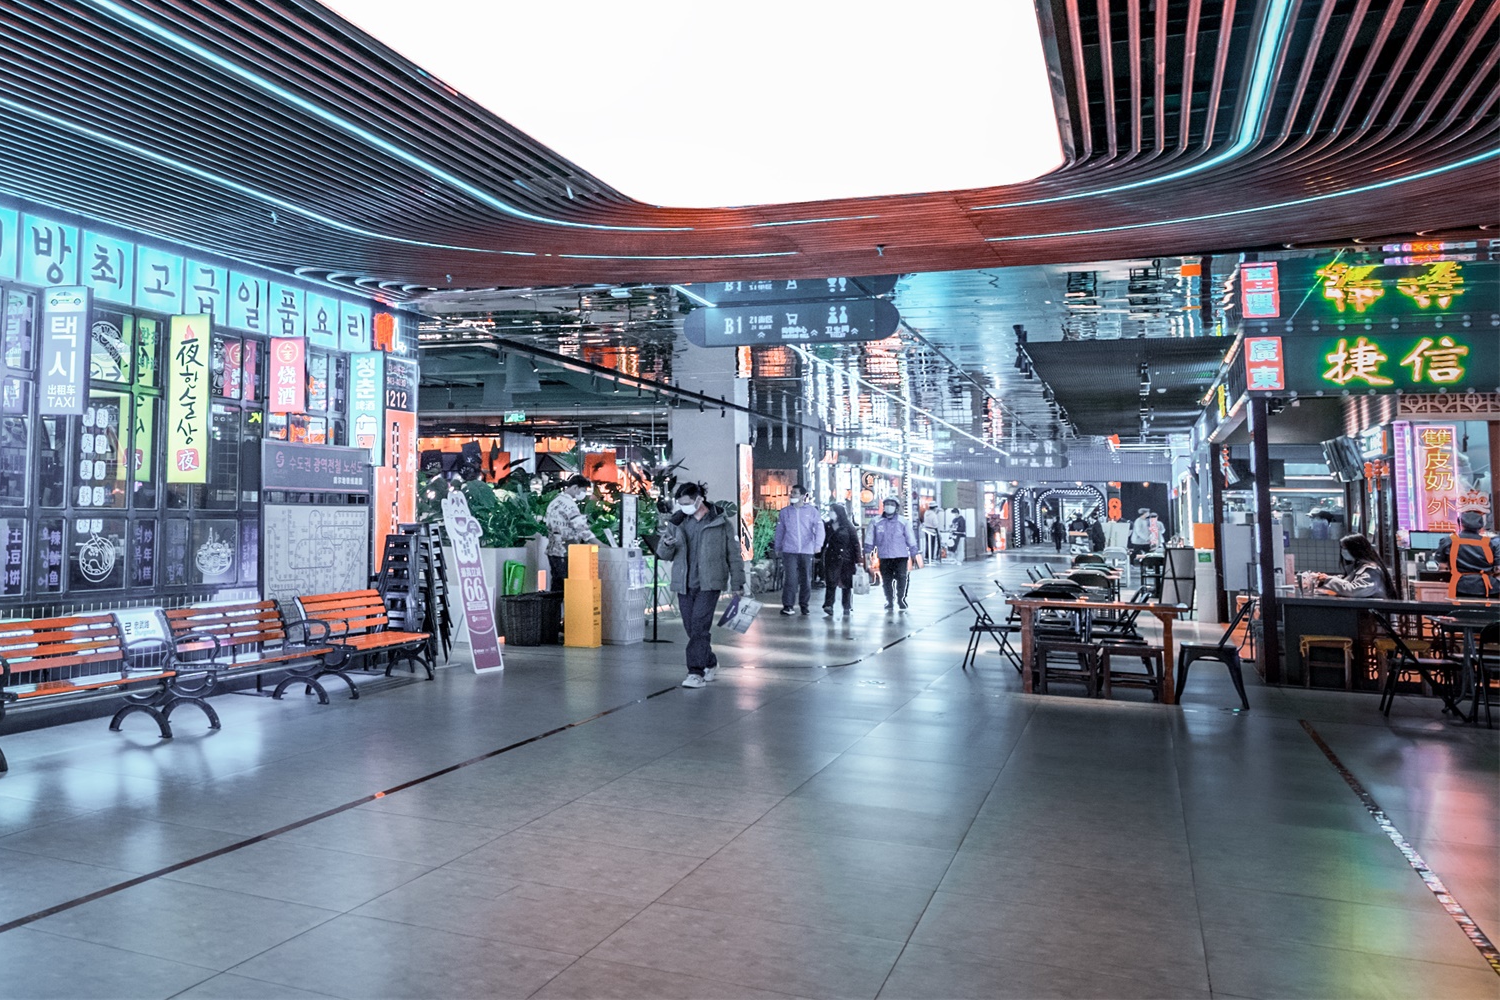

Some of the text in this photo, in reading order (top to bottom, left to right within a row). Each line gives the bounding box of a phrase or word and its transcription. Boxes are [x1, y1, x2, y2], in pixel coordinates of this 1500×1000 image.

[724, 316, 742, 335] B1
[47, 315, 78, 384] 택시
[1249, 338, 1280, 390] 廣東
[1322, 336, 1469, 386] 捷信
[47, 385, 76, 396] 出租车
[355, 356, 376, 399] 청춘
[386, 389, 407, 409] 1212
[48, 396, 76, 408] TAXI
[178, 449, 199, 471] 夜
[289, 456, 311, 472] 수도권
[1421, 428, 1455, 492] 雙皮奶
[9, 528, 22, 586] 土豆饼
[37, 526, 50, 589] 오징어
